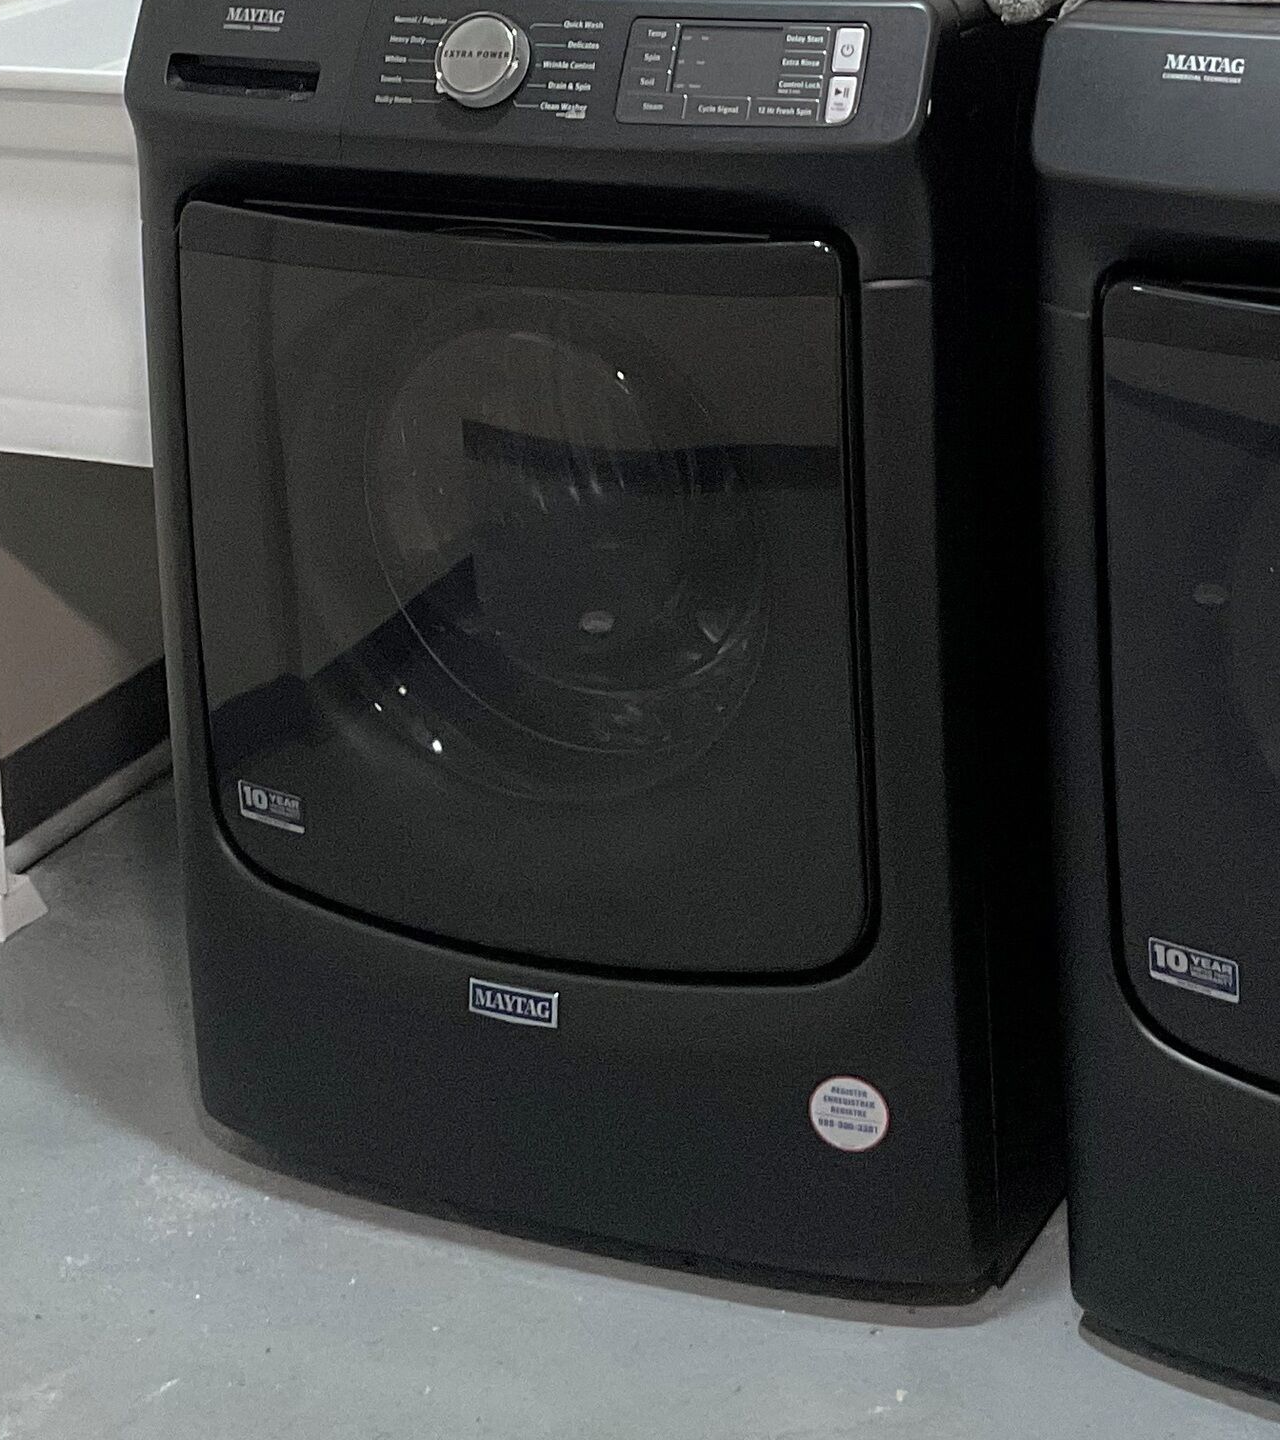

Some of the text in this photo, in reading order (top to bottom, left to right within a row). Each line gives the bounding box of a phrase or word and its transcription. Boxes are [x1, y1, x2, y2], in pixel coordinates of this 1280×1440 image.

[225, 7, 285, 24] MAYTAG
[563, 20, 604, 29] Quick Wash
[648, 29, 667, 39] Temp
[786, 34, 824, 43] Delay Start
[567, 40, 600, 50] Delicates
[443, 49, 511, 59] EXTRA POWER
[644, 53, 660, 62] Spin
[543, 61, 596, 70] Wrinkle Control
[782, 58, 820, 67] Extra Rinse
[1164, 54, 1245, 74] MAYTAG
[548, 81, 567, 90] Drain
[575, 82, 592, 92] Spin
[640, 77, 656, 86] Soil
[778, 80, 804, 88] Control
[540, 102, 588, 112] Clean Washer
[698, 104, 739, 115] Cycle Signal
[795, 107, 812, 116] Spin
[243, 786, 300, 810] 10 YEAR
[1153, 943, 1233, 975] 10 YEAR
[474, 987, 551, 1020] MAYTAG
